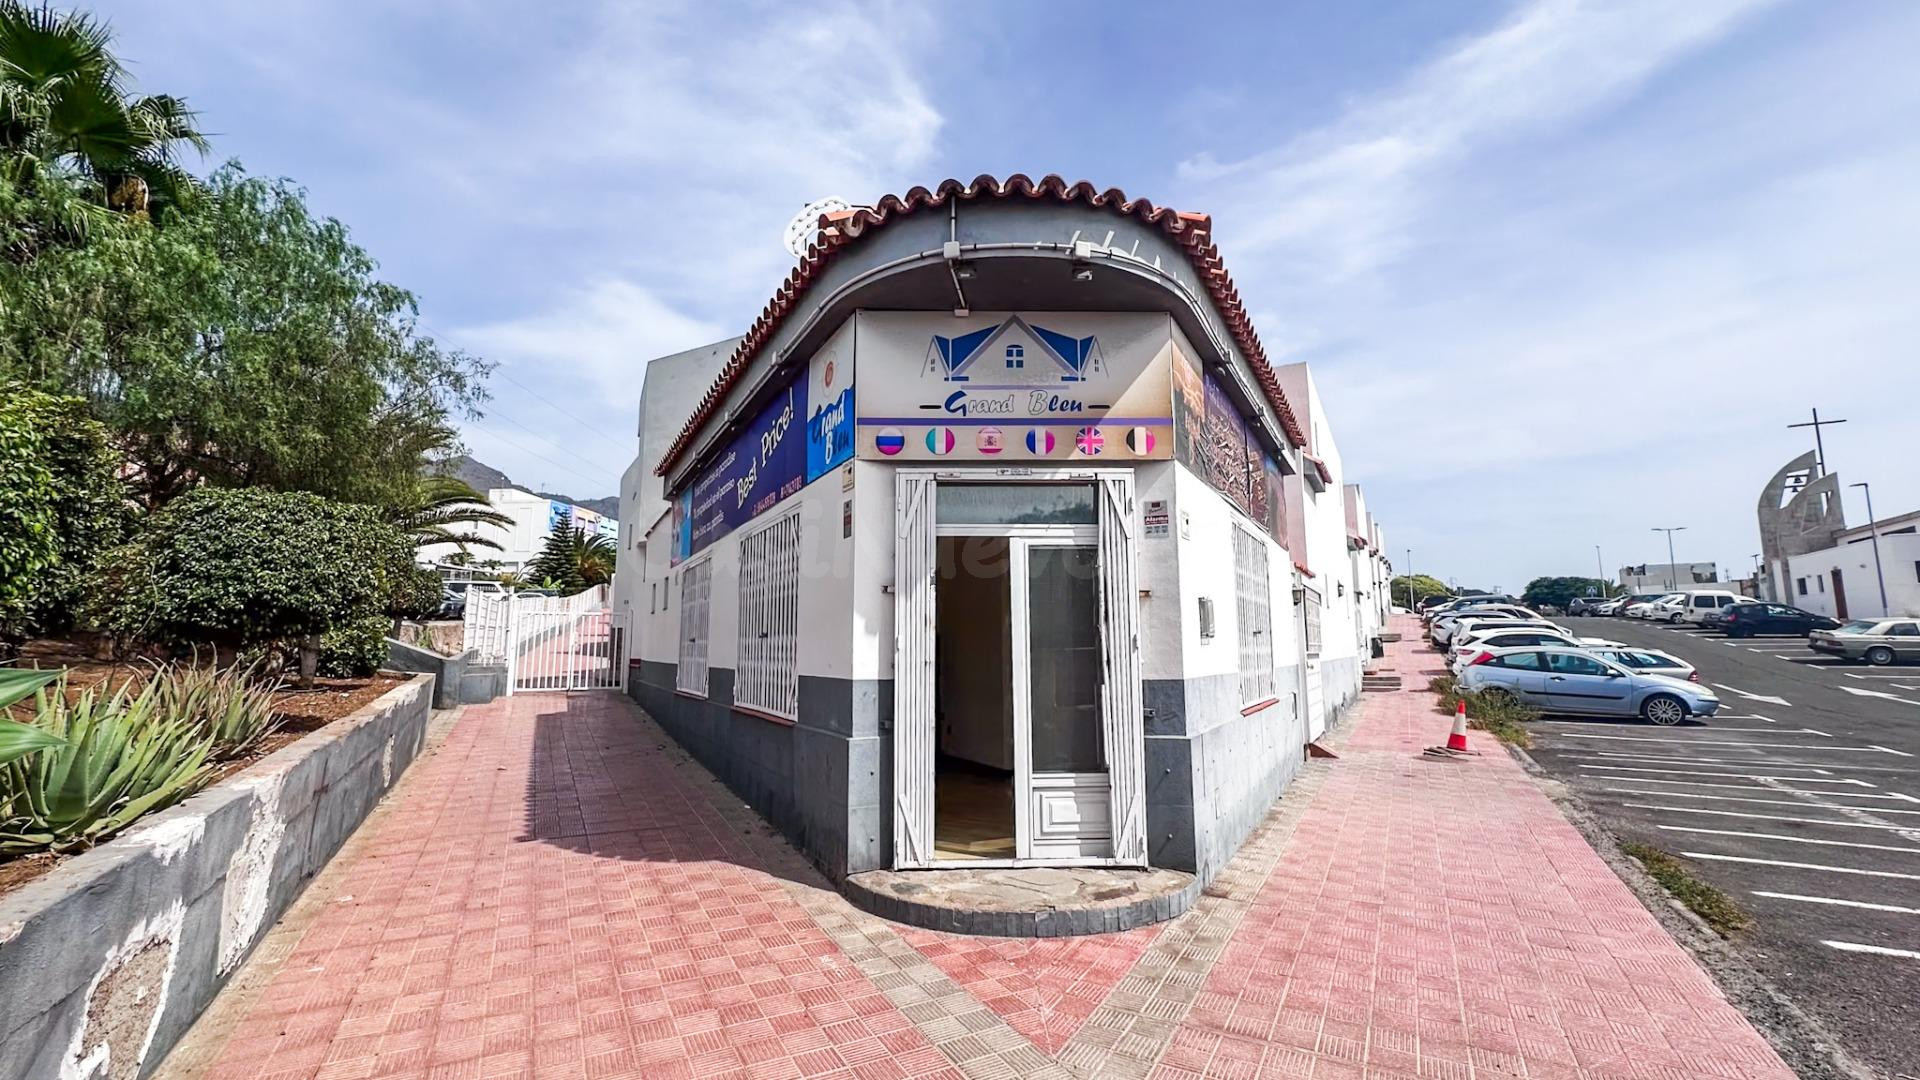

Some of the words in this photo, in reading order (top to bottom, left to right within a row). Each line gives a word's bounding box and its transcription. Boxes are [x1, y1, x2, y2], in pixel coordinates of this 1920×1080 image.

[944, 390, 1015, 417] Grand
[1028, 389, 1082, 416] Bleu
[736, 456, 758, 510] Best
[761, 386, 794, 468] Price!
